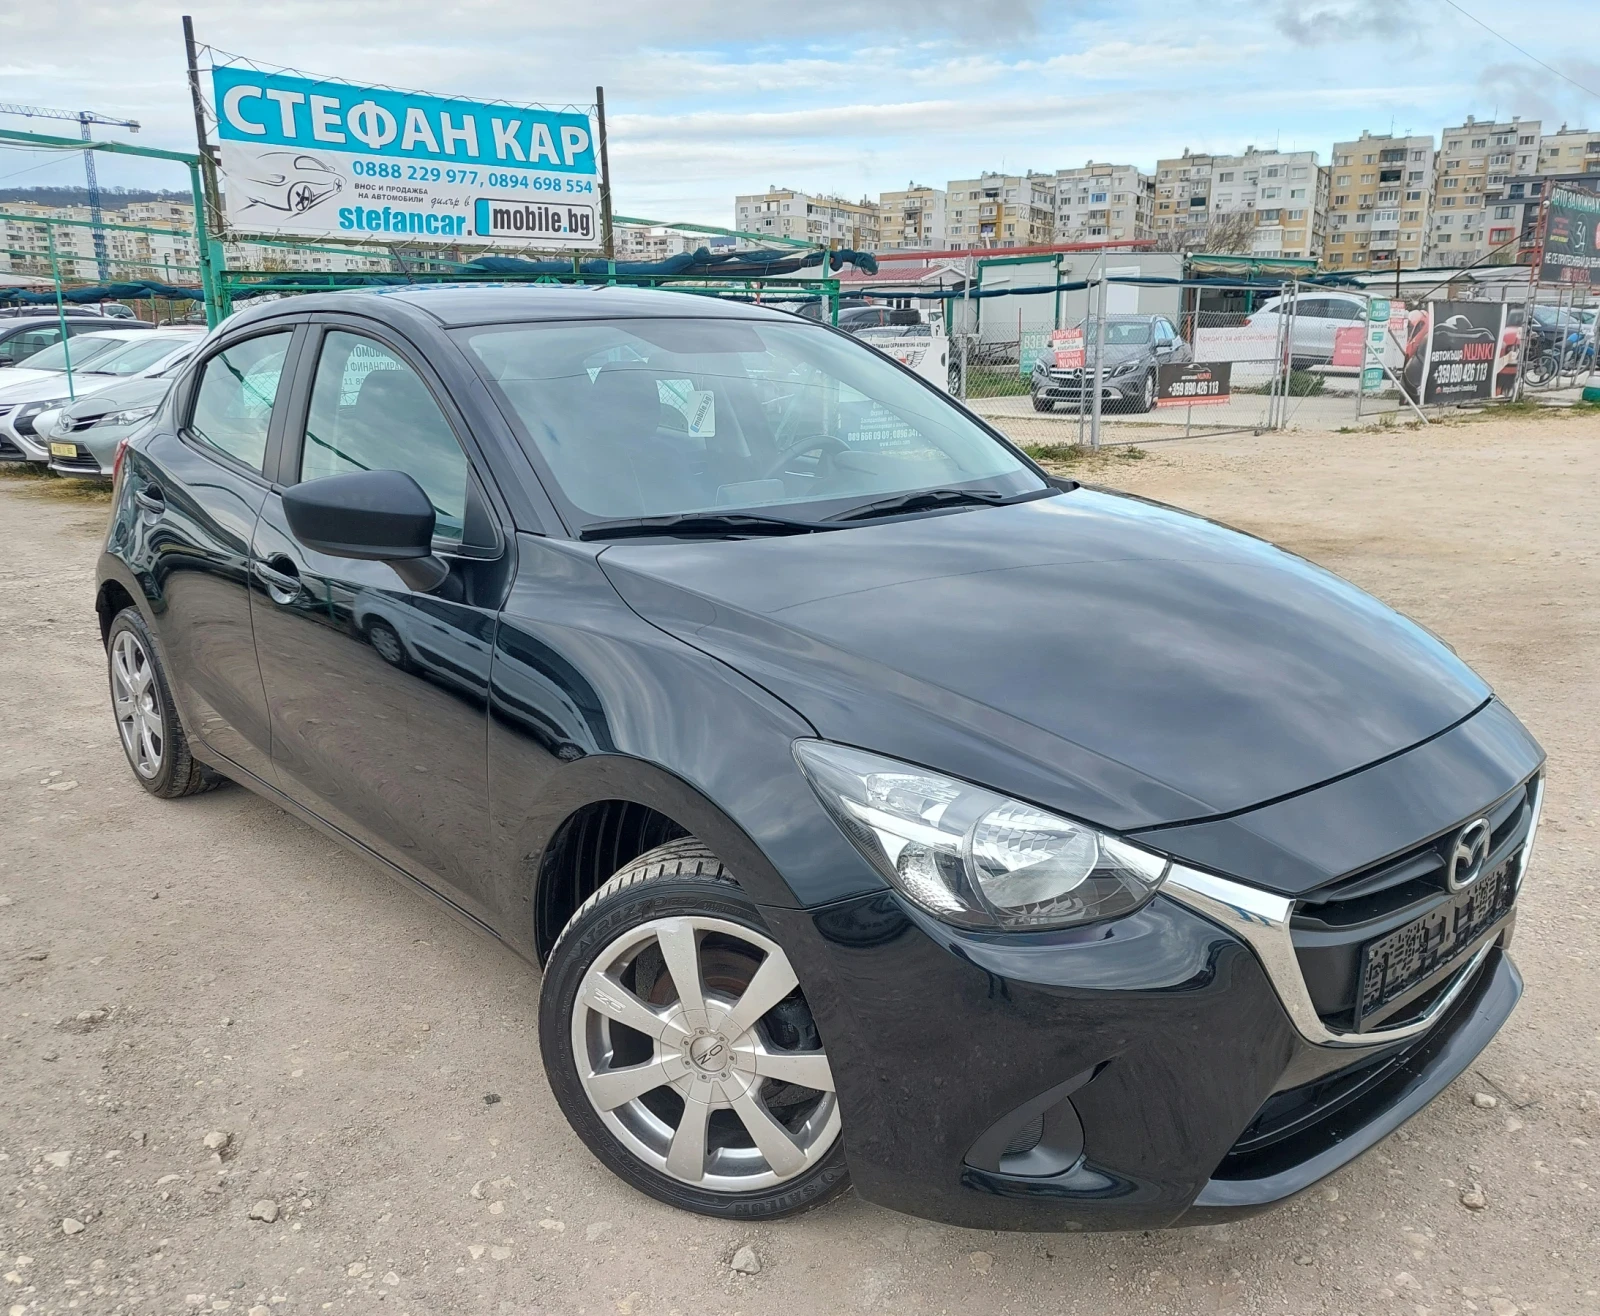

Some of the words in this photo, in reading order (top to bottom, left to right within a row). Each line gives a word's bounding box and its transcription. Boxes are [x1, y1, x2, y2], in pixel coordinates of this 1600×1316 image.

[223, 84, 480, 158] СТЕФАН
[491, 117, 590, 167] КАР
[352, 160, 402, 179] 0888
[407, 165, 441, 182] 229
[445, 169, 484, 188] 977,
[488, 172, 529, 189] 0894
[533, 176, 562, 192] 698
[566, 179, 593, 194] 554
[354, 182, 377, 191] ВНОС
[378, 184, 385, 192] И
[386, 185, 428, 195] ПРОДАЖБА
[358, 192, 369, 200] НА
[371, 193, 424, 203] АВТОМОБИЛИ
[492, 205, 590, 237] mobile.bg
[1053, 329, 1081, 340] ПАРКИНГ
[1463, 343, 1495, 360] NUNKI
[1059, 357, 1081, 368] NUNKI
[1433, 363, 1451, 385] +359
[1450, 363, 1463, 383] 890
[1462, 363, 1476, 382] 426
[1475, 362, 1488, 381] 113
[1168, 382, 1184, 396] +359
[1184, 382, 1197, 396] 890
[1197, 381, 1208, 395] 426
[1208, 380, 1219, 394] 113
[861, 431, 873, 440] 666
[873, 430, 881, 439] 09
